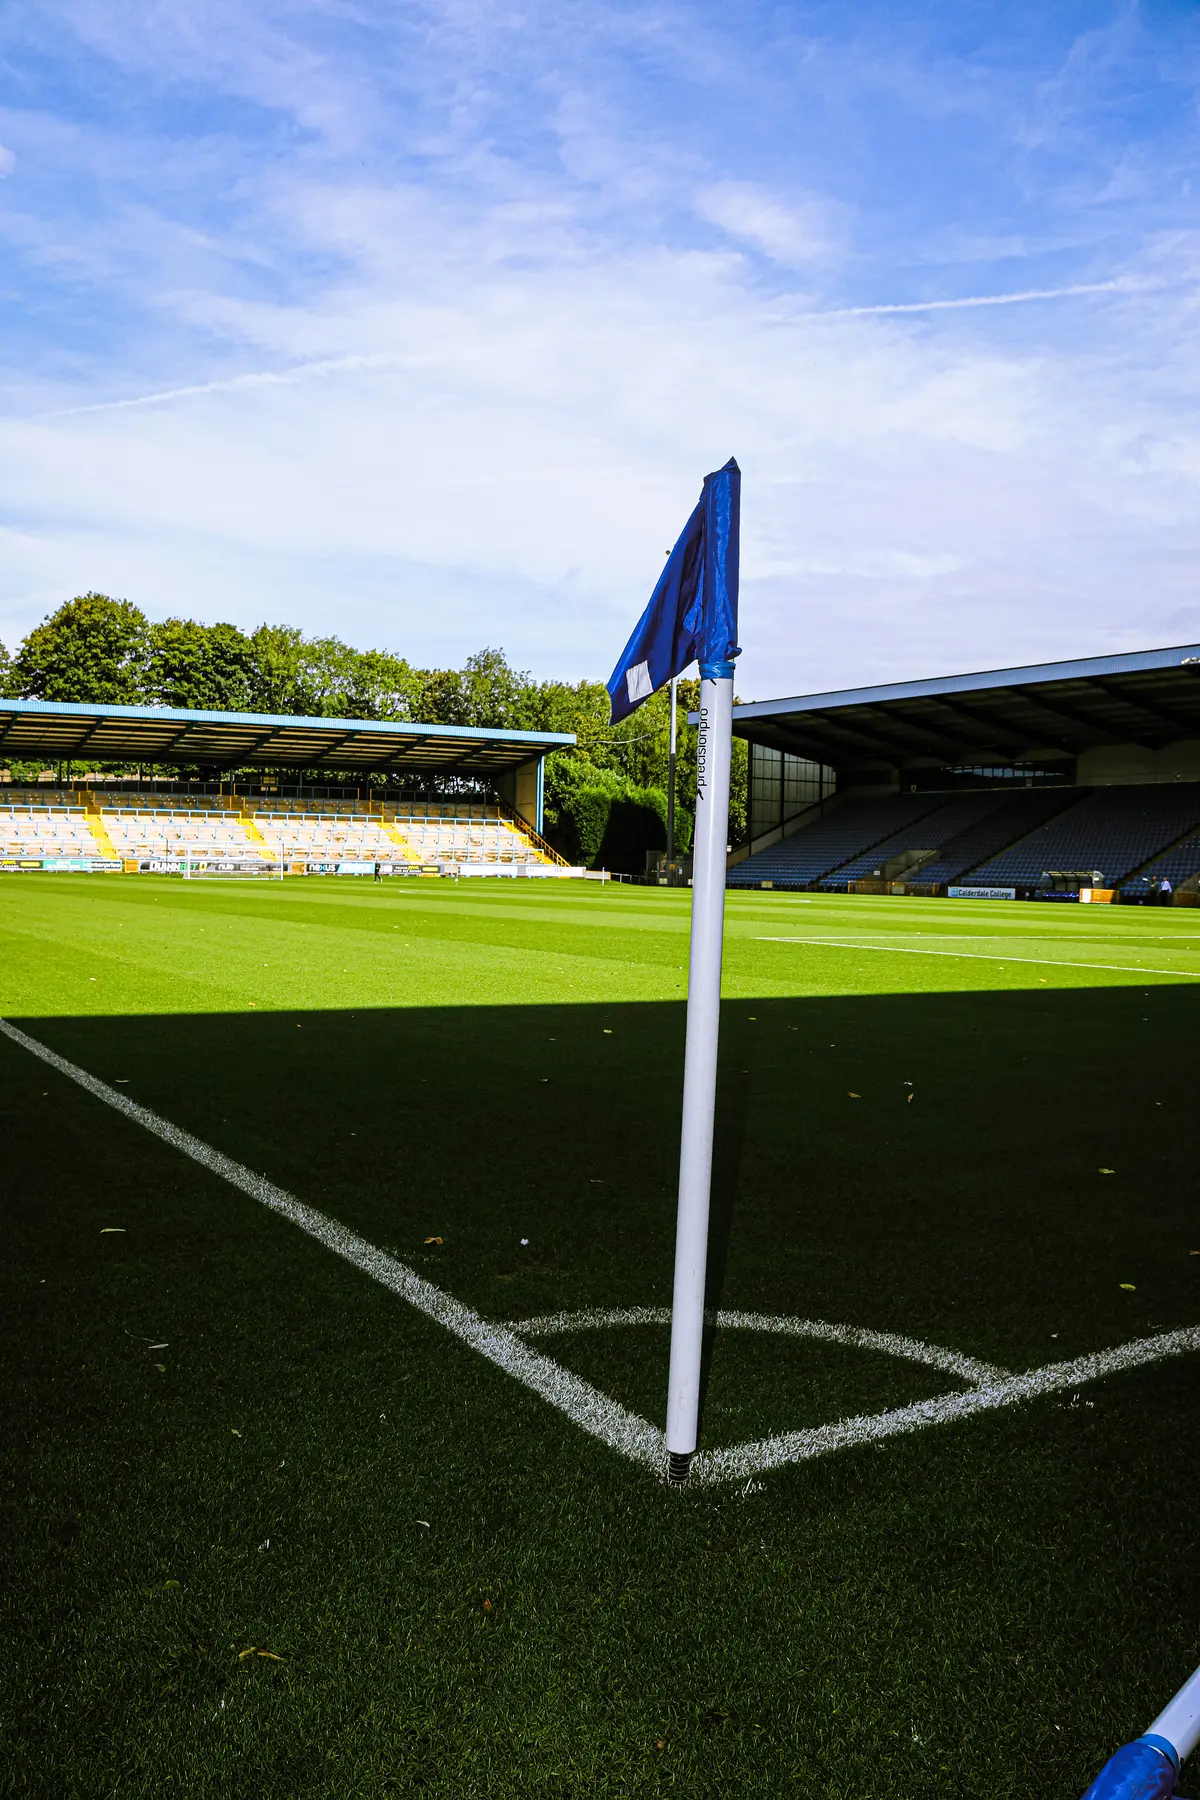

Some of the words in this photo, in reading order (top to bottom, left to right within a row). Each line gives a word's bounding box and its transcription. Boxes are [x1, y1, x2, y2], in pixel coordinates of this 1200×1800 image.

[697, 708, 710, 787] precisionpro
[309, 864, 336, 872] nexus
[958, 889, 989, 897] Calderdale
[990, 890, 1012, 899] College
